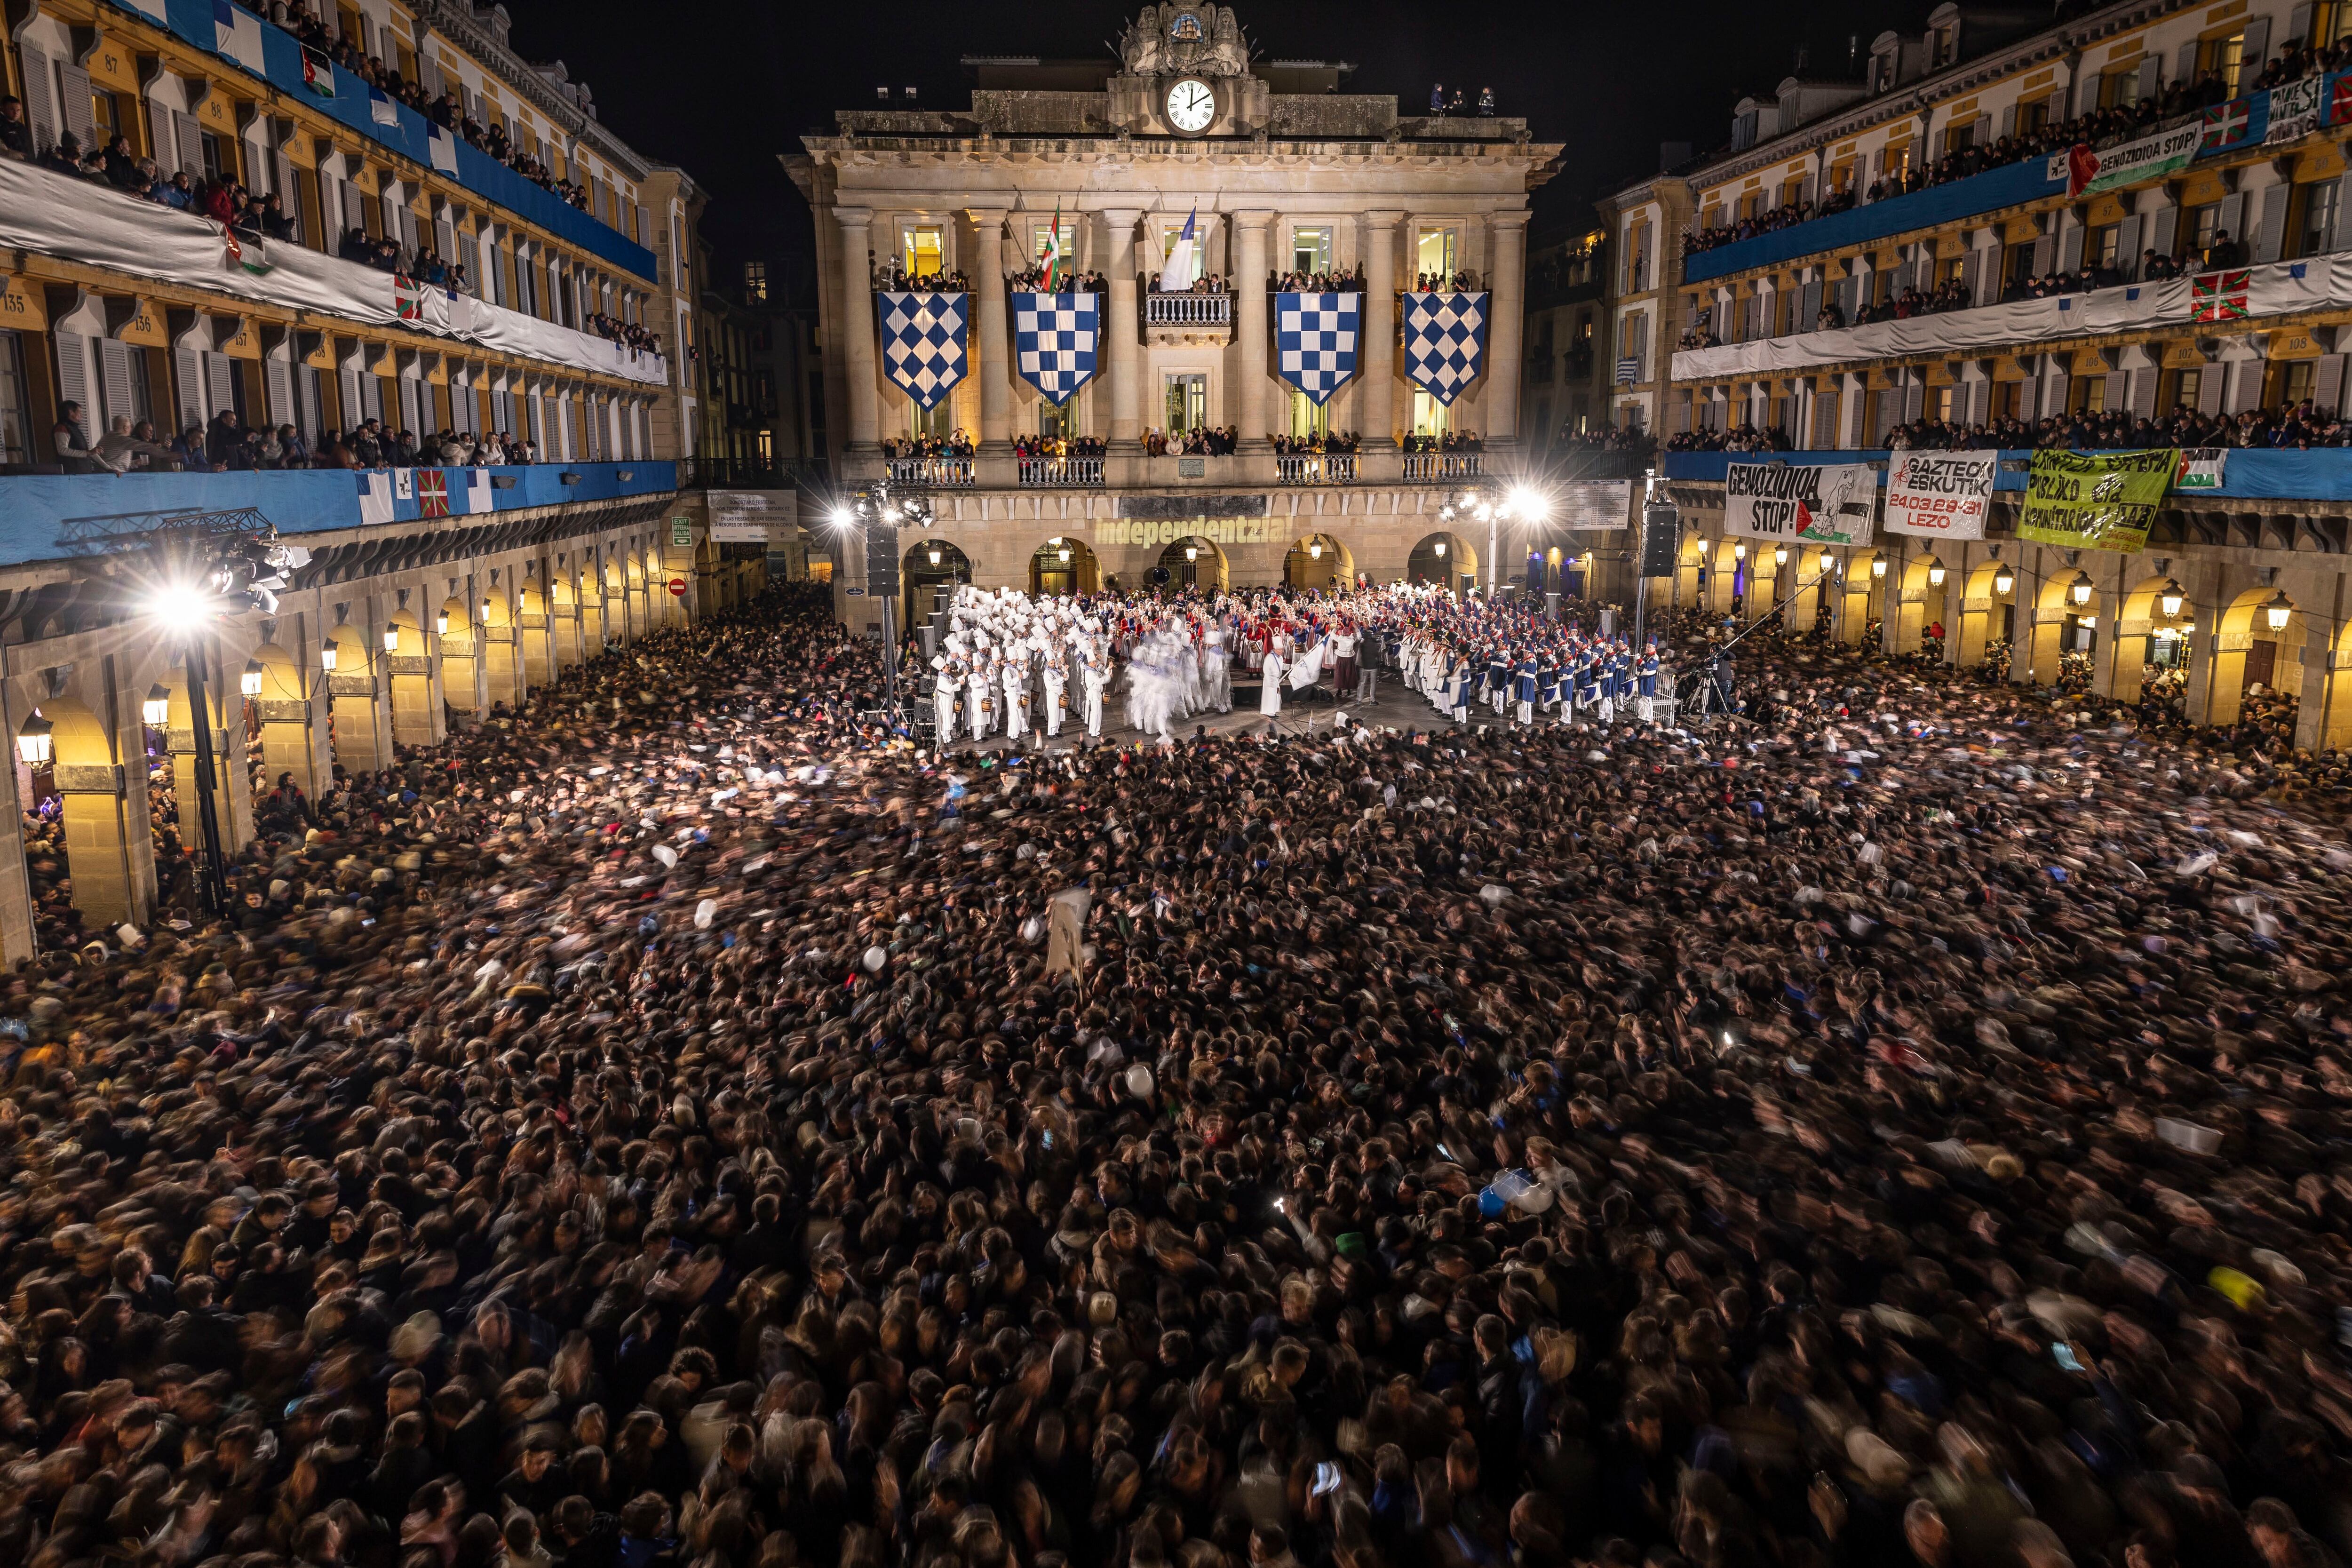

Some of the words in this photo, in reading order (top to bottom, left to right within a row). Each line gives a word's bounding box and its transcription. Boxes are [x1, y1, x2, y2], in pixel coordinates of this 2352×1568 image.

[105, 54, 117, 74] 87
[211, 102, 222, 119] 88
[1898, 125, 1901, 135] 5
[294, 140, 303, 155] 89
[2100, 143, 2160, 172] GENOZIDIOA
[2163, 127, 2197, 154] STOP!
[362, 170, 369, 184] 90
[417, 197, 423, 208] 91
[2103, 205, 2113, 216] 57
[2018, 225, 2026, 235] 56
[1947, 241, 1955, 251] 55
[1886, 255, 1892, 263] 54
[4, 294, 24, 313] 135
[135, 316, 151, 332] 136
[236, 332, 247, 346] 137
[2289, 337, 2307, 350] 108
[315, 345, 326, 358] 138
[2179, 347, 2193, 359] 107
[2006, 364, 2016, 374] 105
[2086, 357, 2098, 367] 106
[1937, 370, 1946, 379] 104
[1908, 458, 1994, 479] GAZTEON
[2099, 450, 2173, 474] SISTEMA
[1728, 465, 1823, 500] GENOZIDIOA
[1907, 474, 1990, 497] ESKUTIK
[2029, 474, 2080, 501] PUBLIKO
[1889, 493, 1982, 516] 24.03.29-31
[1752, 500, 1796, 533] STOP!
[1907, 512, 1950, 529] LEZO
[2120, 506, 2151, 527] LAB
[1095, 513, 1293, 549] independentzia!
